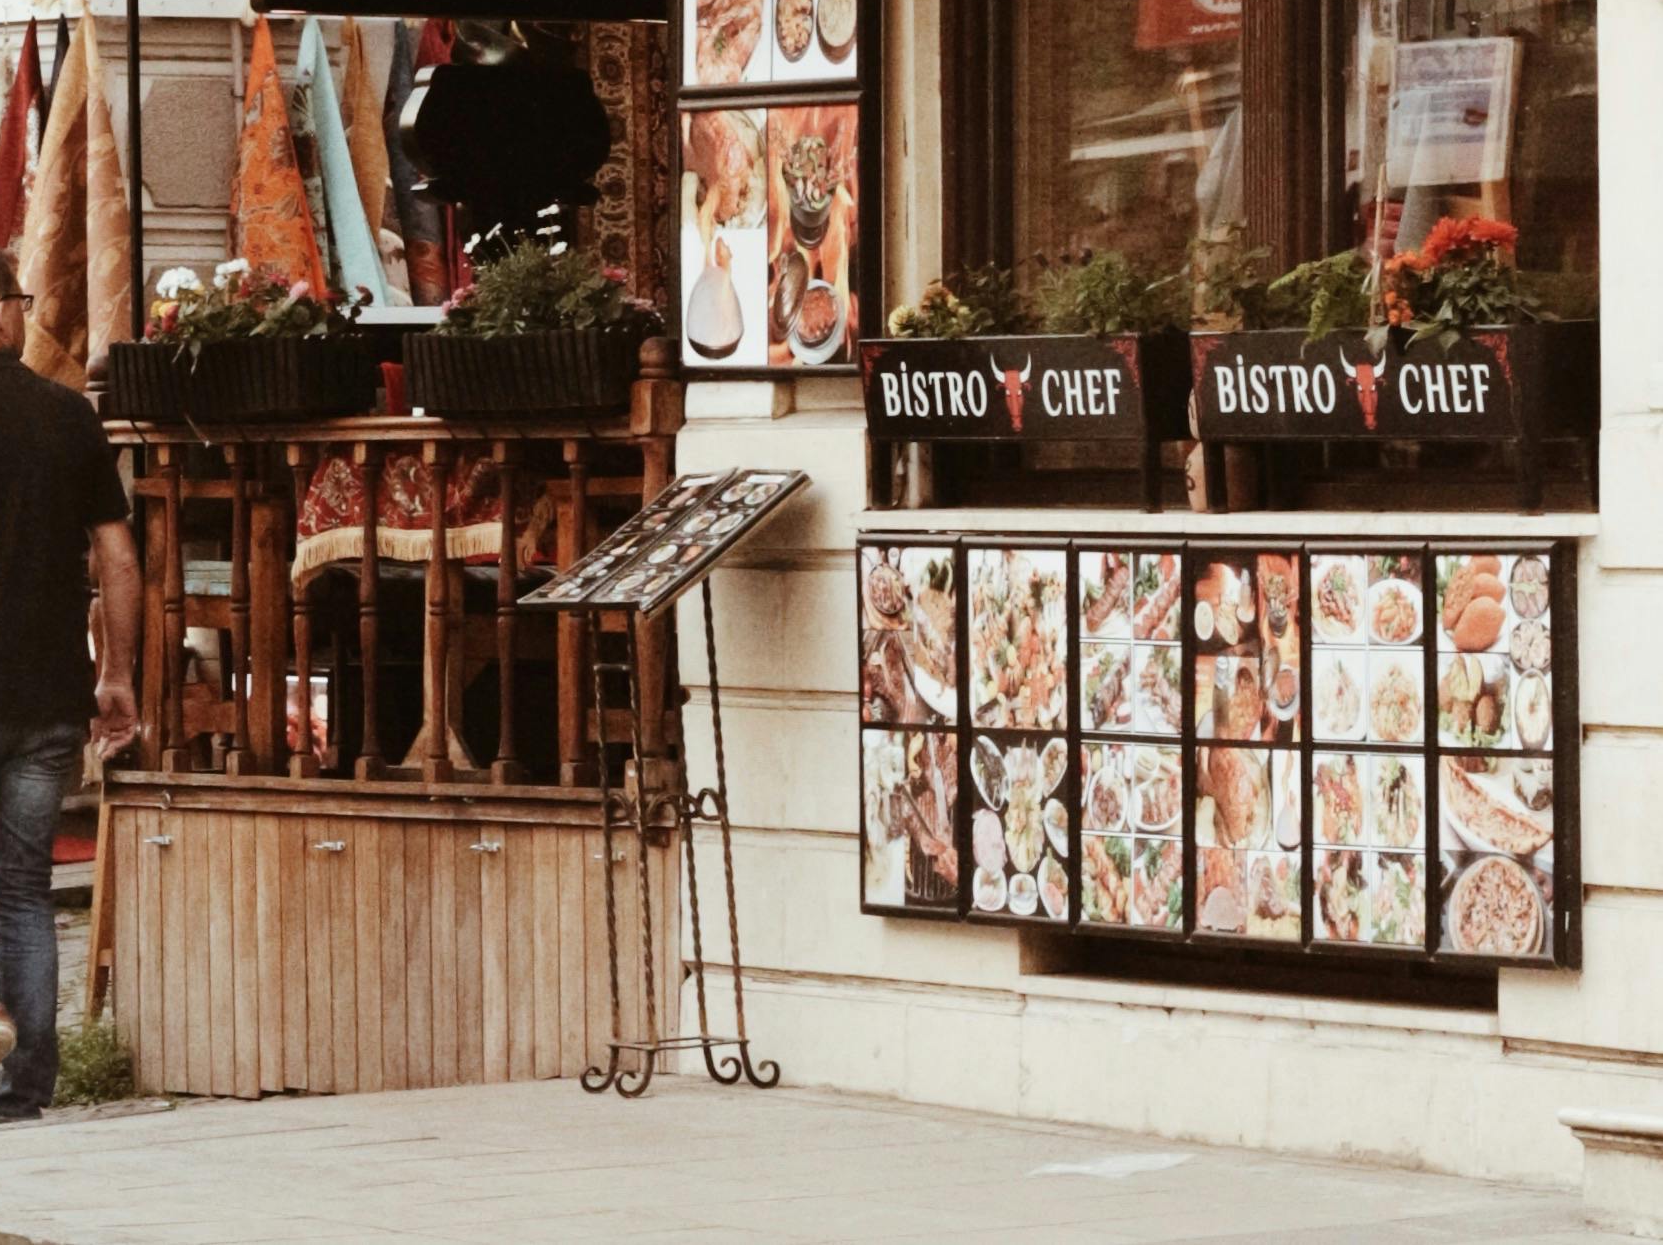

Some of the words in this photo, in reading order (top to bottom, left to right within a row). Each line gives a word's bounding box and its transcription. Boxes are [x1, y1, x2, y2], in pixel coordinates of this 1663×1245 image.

[881, 361, 987, 417] BİSTRO
[1042, 368, 1121, 416] CHEF
[1215, 354, 1336, 415] BİSTRO
[1399, 362, 1491, 414] CHEF
